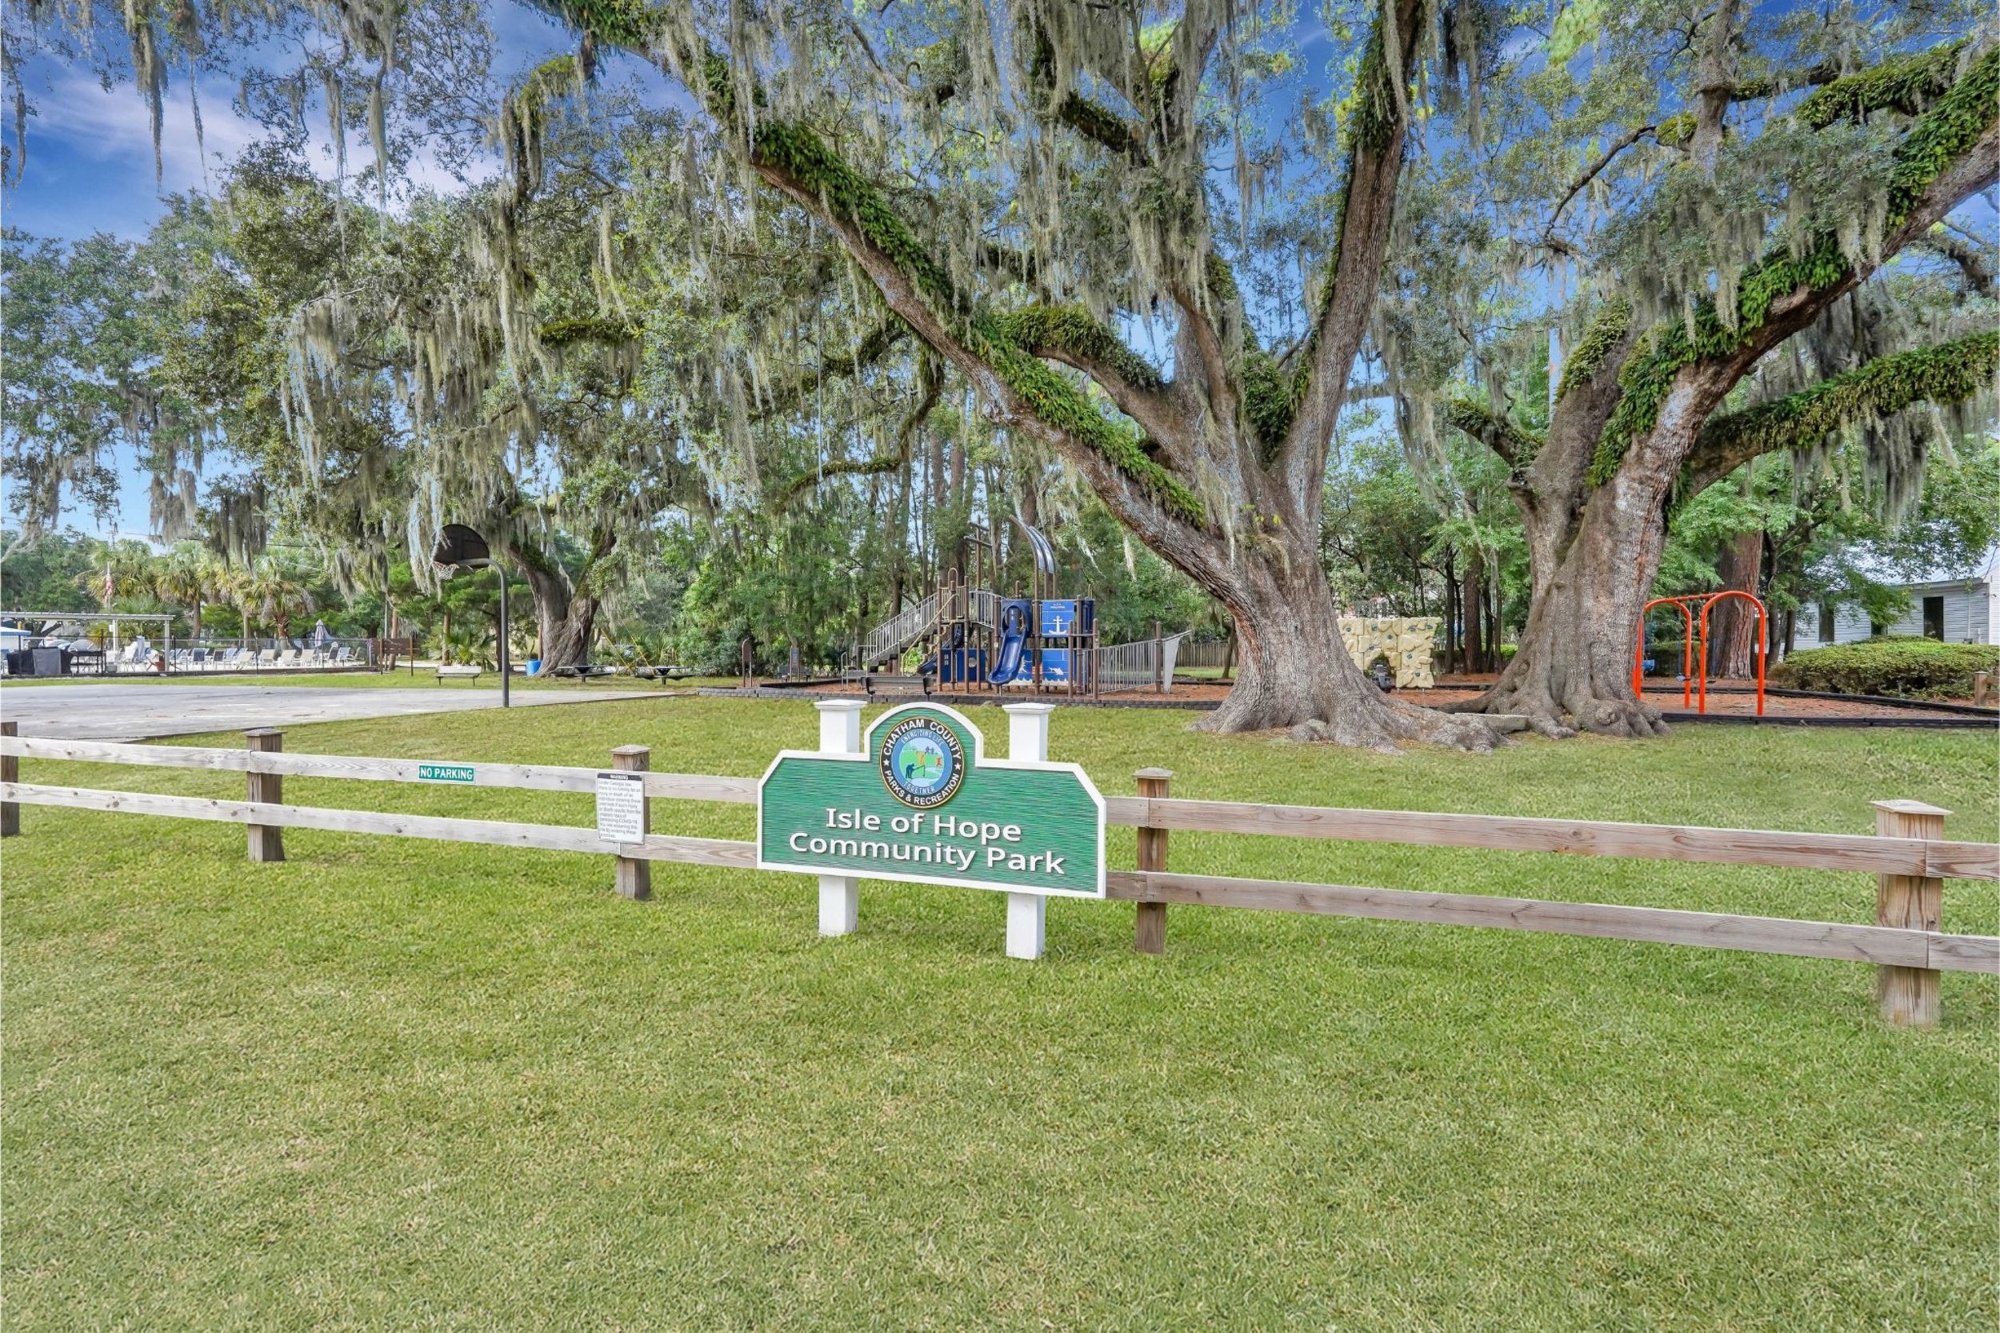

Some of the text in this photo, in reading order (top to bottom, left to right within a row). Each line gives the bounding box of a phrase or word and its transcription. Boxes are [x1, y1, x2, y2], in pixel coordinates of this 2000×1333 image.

[883, 719, 962, 760] CHATHAM COUNTY
[420, 767, 473, 780] NO PARKING
[885, 769, 960, 806] PARKS & RECREATION
[826, 807, 1022, 846] Isle of Hope
[789, 832, 1066, 875] Community Park
